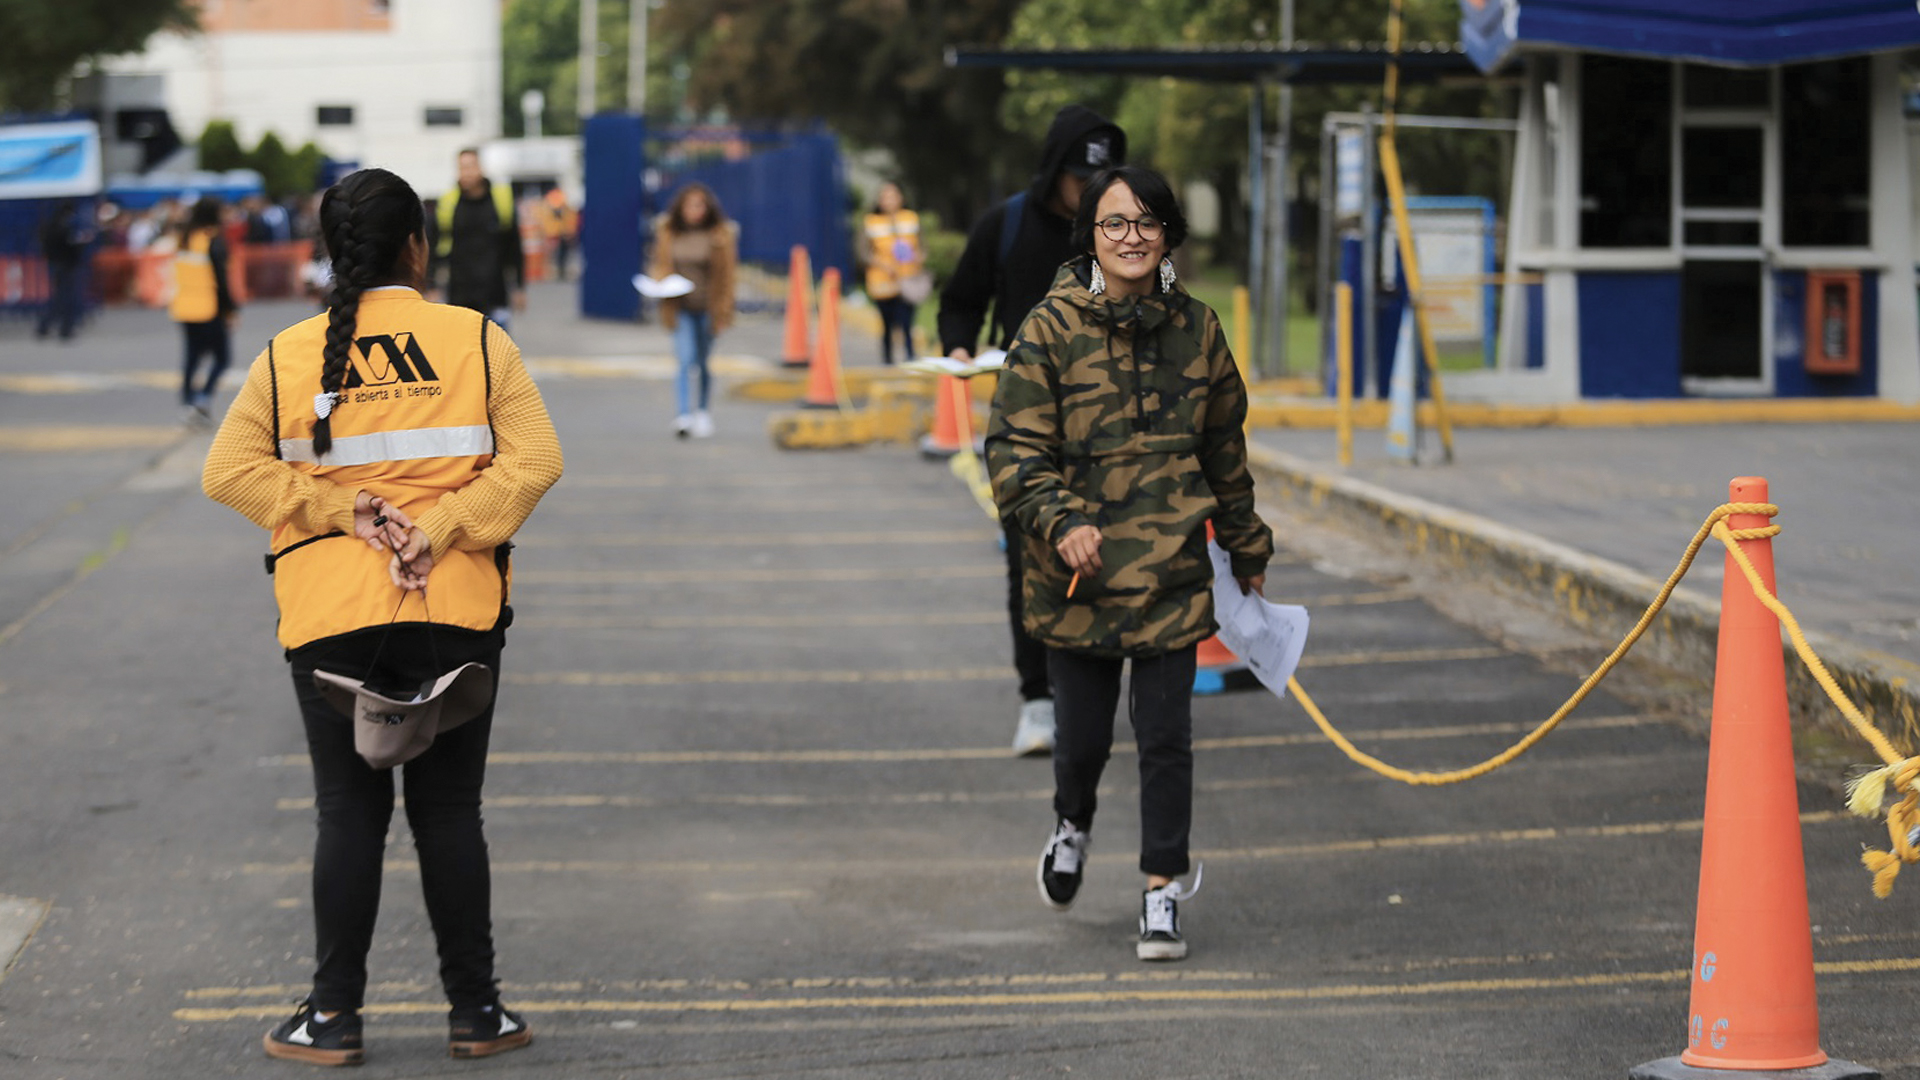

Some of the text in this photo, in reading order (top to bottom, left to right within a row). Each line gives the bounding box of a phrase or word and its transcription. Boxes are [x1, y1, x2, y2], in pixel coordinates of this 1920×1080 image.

[355, 389, 389, 403] abierta
[394, 386, 402, 398] al
[407, 385, 442, 399] tiempo
[1693, 951, 1717, 982] G
